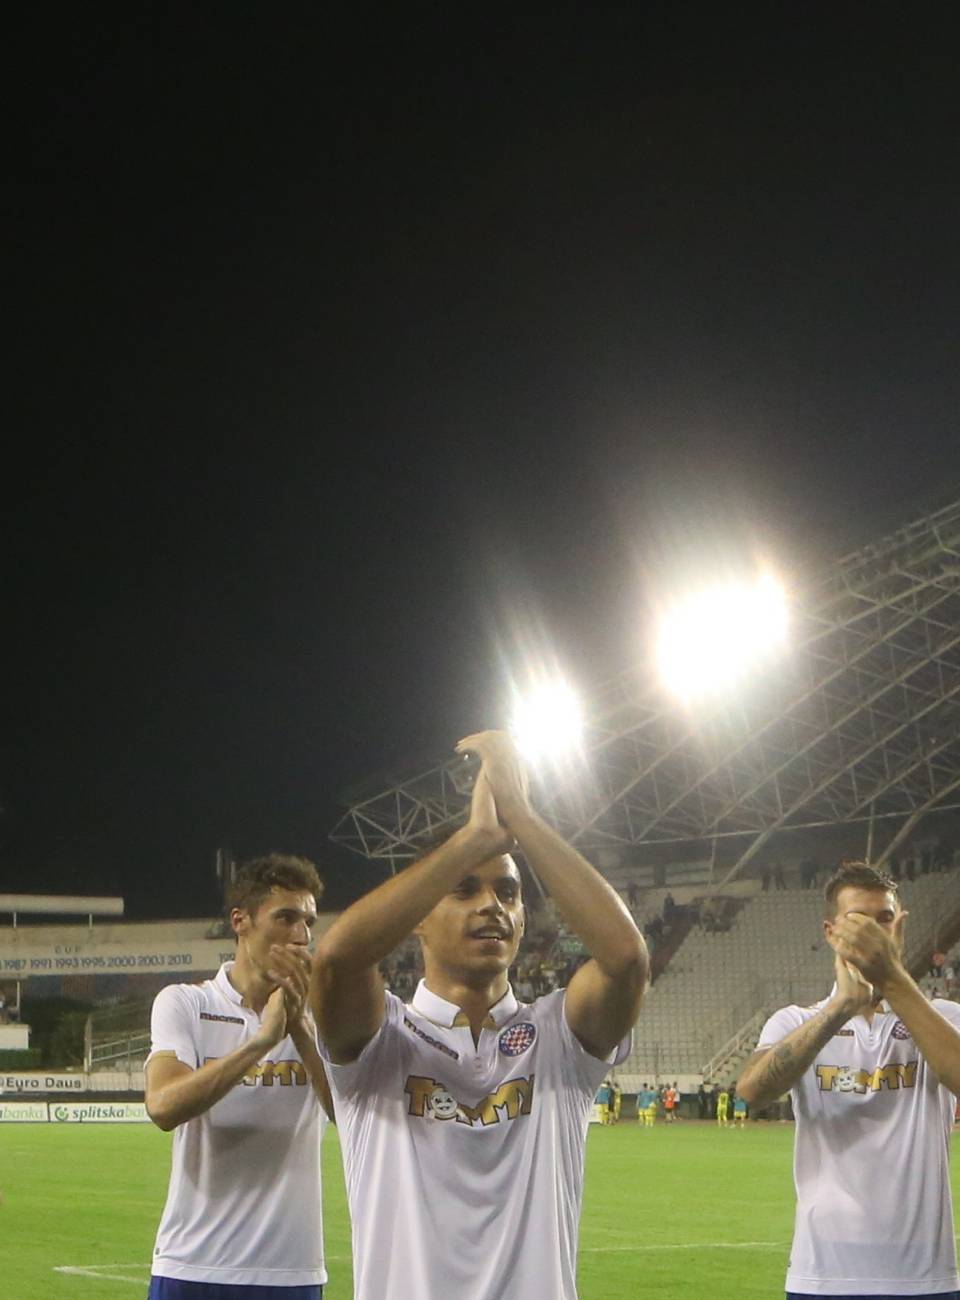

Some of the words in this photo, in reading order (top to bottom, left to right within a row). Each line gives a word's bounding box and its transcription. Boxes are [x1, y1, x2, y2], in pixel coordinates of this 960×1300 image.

[30, 958, 51, 969] 1991
[107, 955, 136, 968] 2000
[167, 953, 193, 965] 2010
